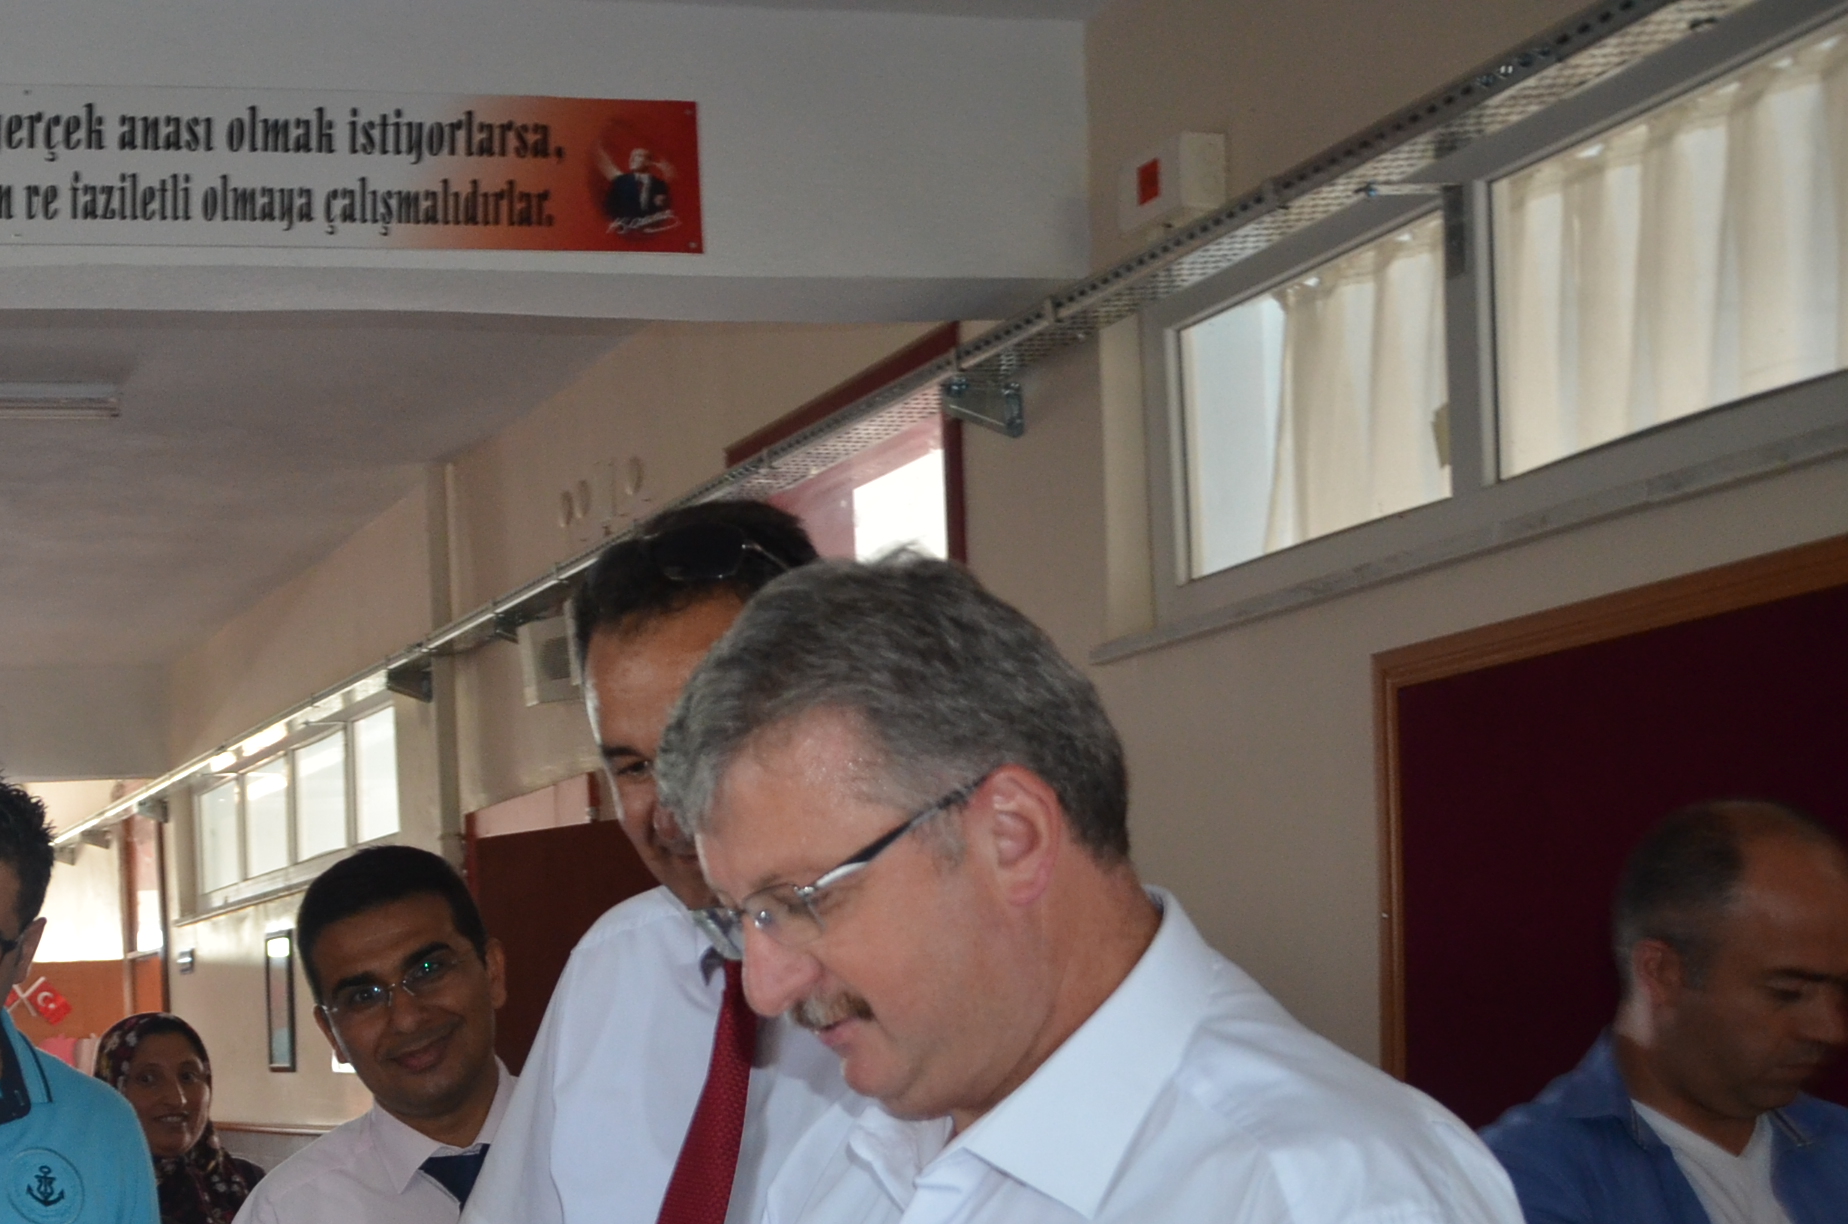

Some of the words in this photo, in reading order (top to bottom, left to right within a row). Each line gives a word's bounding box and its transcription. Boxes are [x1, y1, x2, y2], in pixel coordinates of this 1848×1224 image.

[117, 112, 215, 152] anası
[226, 106, 336, 154] olmak
[349, 107, 566, 164] istiyorlarsa,
[23, 181, 58, 220] ve
[70, 172, 192, 222] faziletli
[202, 174, 312, 231] olmaya
[323, 176, 554, 235] çalışmalıdırlar.
